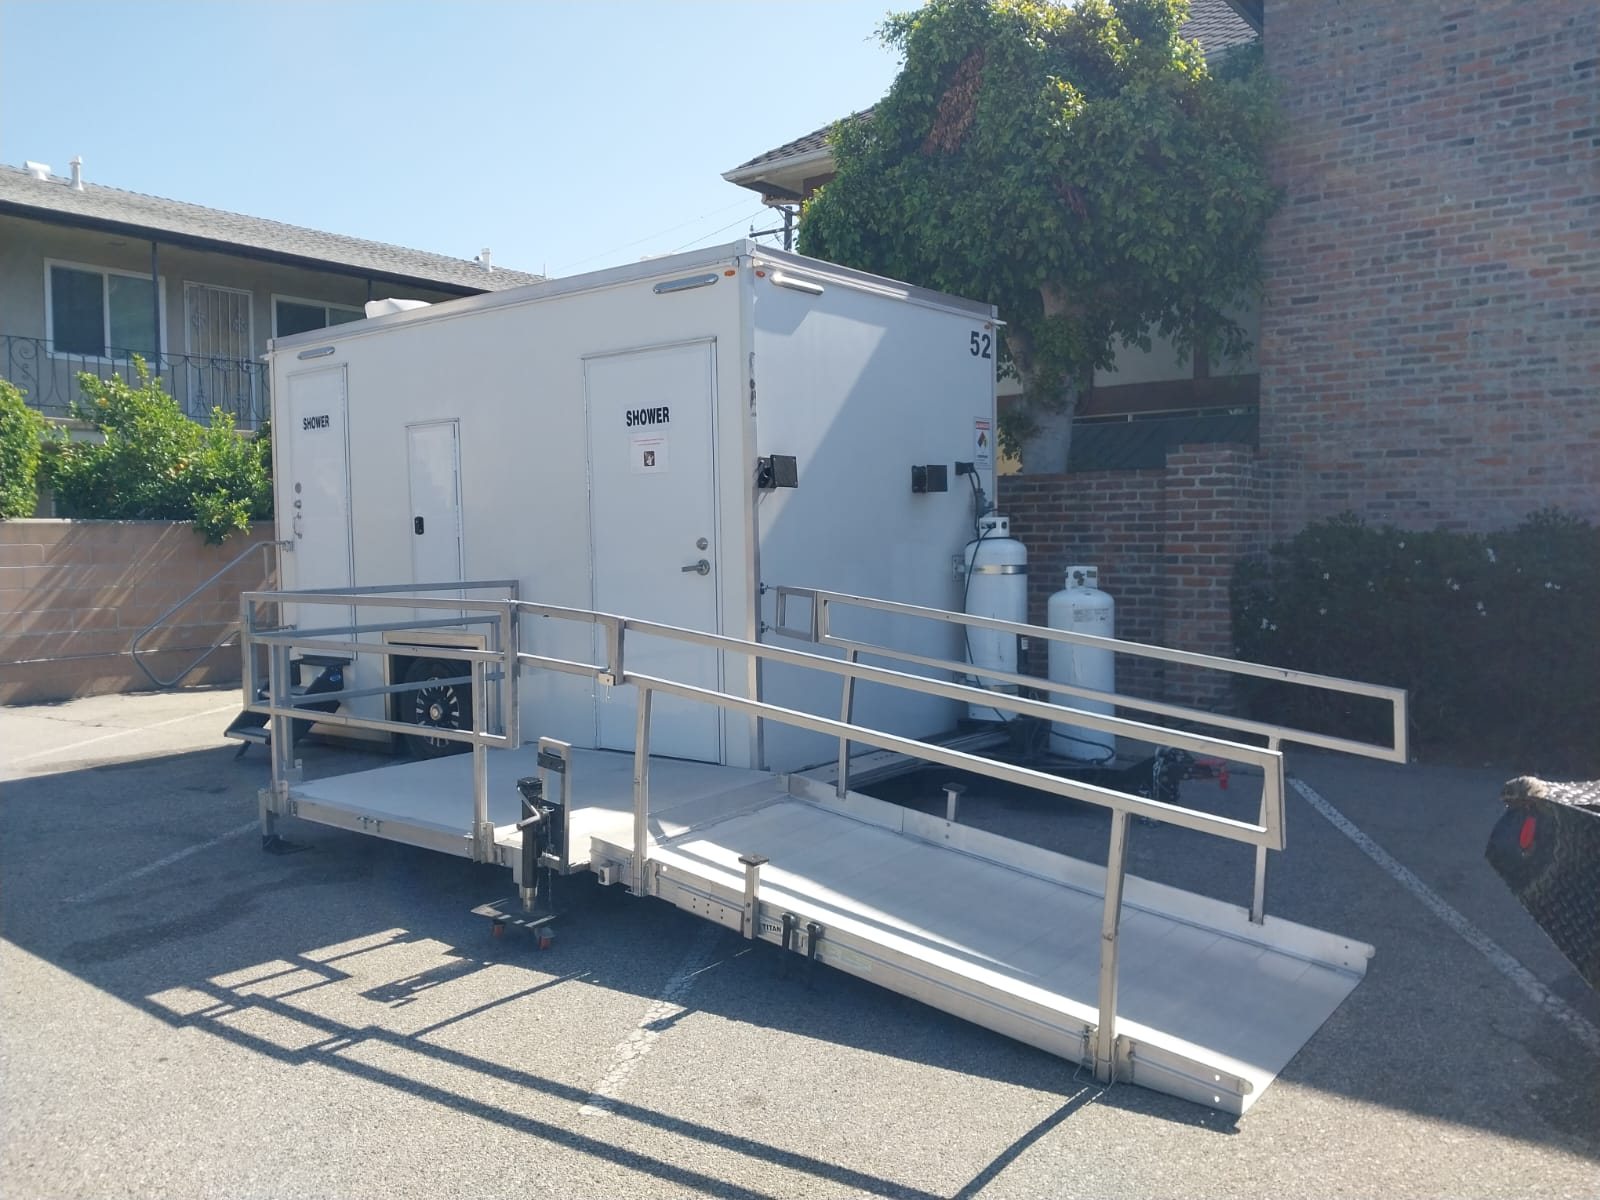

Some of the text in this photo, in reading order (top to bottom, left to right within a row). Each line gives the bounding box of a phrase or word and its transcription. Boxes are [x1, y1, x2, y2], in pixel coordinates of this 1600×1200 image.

[970, 331, 991, 359] 52
[303, 415, 330, 430] SHOWER
[626, 407, 670, 427] SHOWER
[762, 923, 781, 932] TITAN
